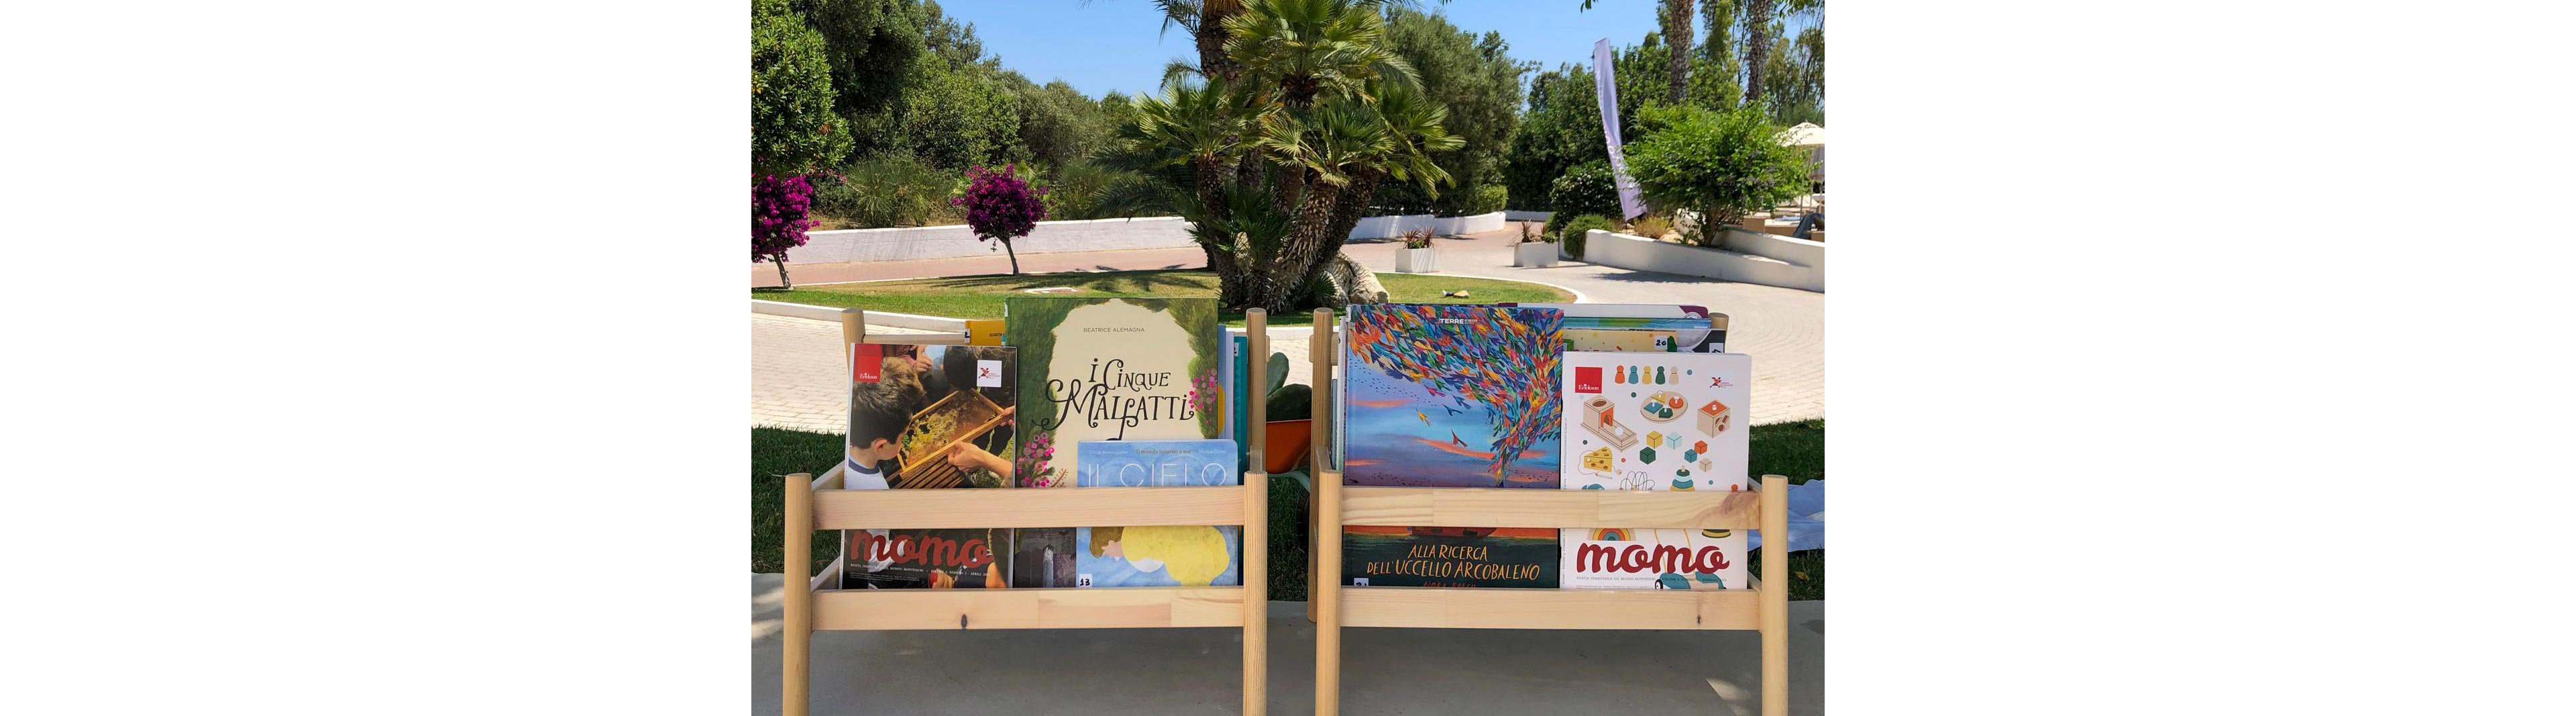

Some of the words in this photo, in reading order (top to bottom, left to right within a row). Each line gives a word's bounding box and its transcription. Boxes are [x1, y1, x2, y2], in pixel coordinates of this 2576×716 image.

[851, 530, 994, 568] momo
[1407, 544, 1436, 560] ALLA
[1439, 545, 1488, 562] RICERCA
[1576, 542, 1730, 574] momo
[1366, 560, 1452, 578] DELL'UCCELLO
[1454, 560, 1540, 580] ARCOBALENO
[1079, 578, 1091, 586] 13
